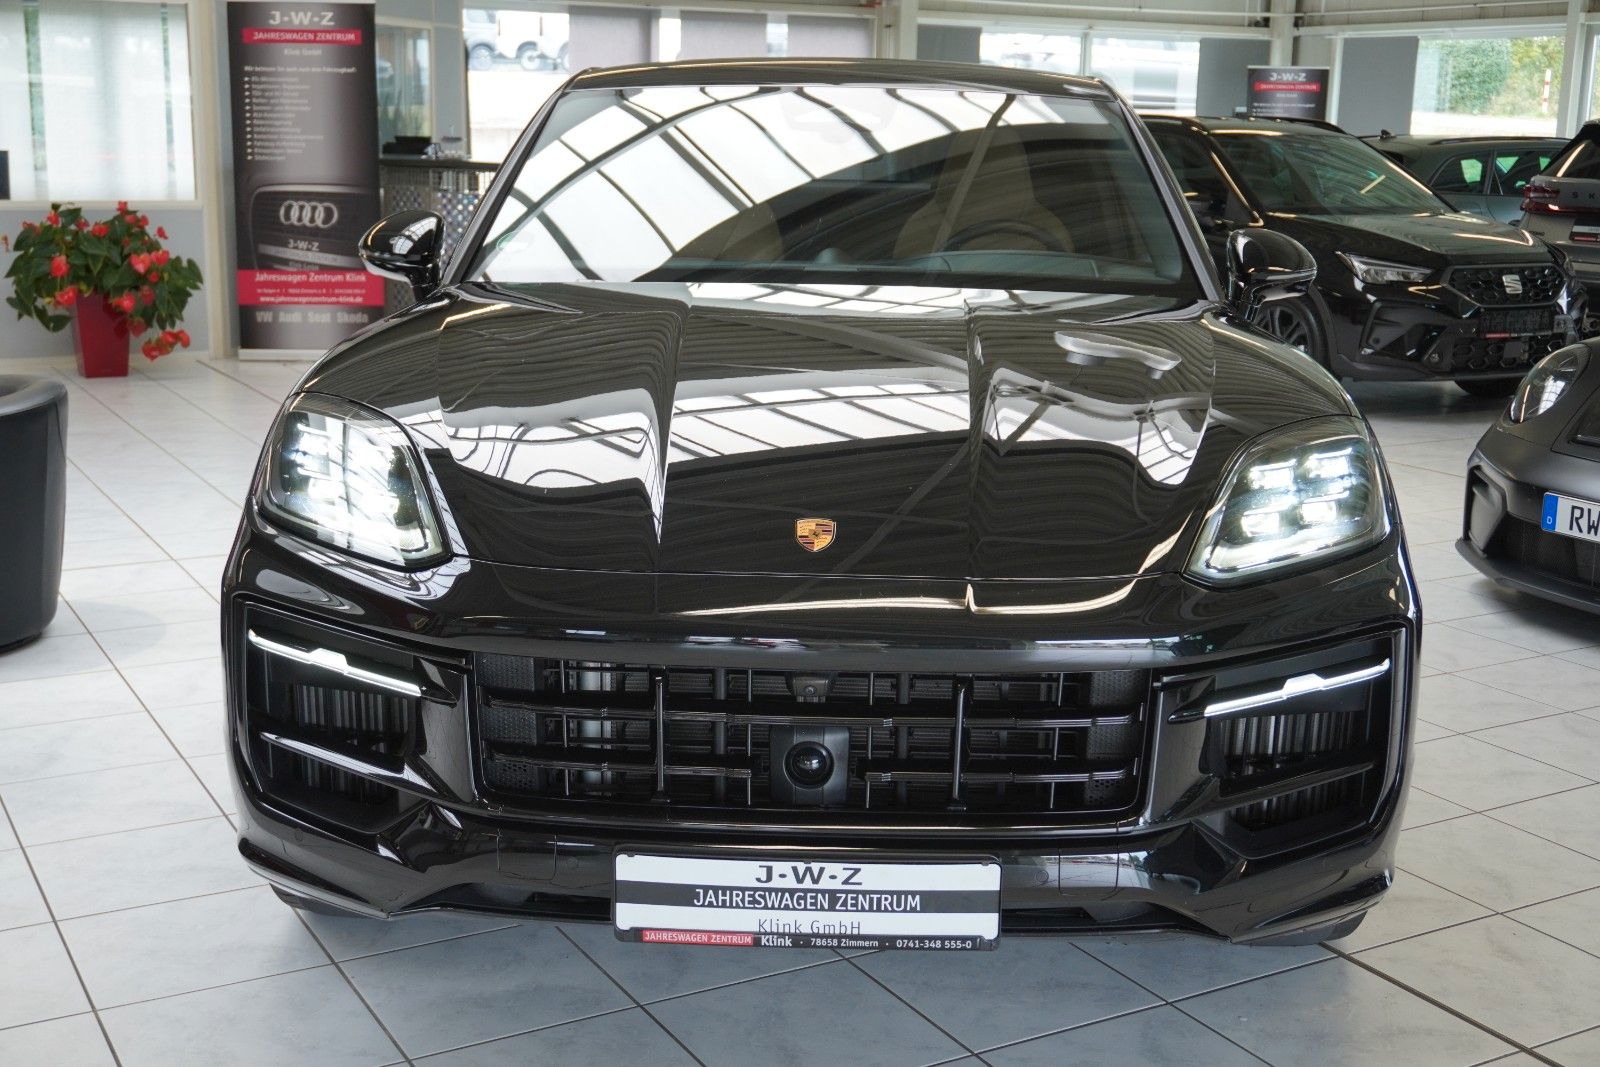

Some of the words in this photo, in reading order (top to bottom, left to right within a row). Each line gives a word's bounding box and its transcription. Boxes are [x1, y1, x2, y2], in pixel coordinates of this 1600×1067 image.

[253, 31, 314, 41] JAHRESWAGEN
[315, 32, 356, 41] ZENTRUM
[255, 273, 307, 283] Jahreswagen
[309, 272, 344, 282] Zentrum
[345, 273, 366, 282] Klink
[256, 311, 273, 323] VW
[279, 311, 302, 323] Audi
[307, 311, 332, 323] Seat
[1546, 516, 1553, 525] D
[1569, 505, 1600, 536] RW
[693, 888, 829, 910] JAHRESWAGEN
[835, 893, 921, 911] ZENTRUM
[758, 918, 802, 934] Klink
[810, 920, 861, 935] GmbH
[645, 931, 708, 942] JAHRESWAGEN
[710, 935, 752, 944] ZENTRUM
[760, 935, 793, 947] Klink
[810, 938, 838, 946] 78658
[840, 938, 879, 947] Zimmern
[896, 940, 942, 948] 0741-348
[944, 940, 972, 949] 555-0
